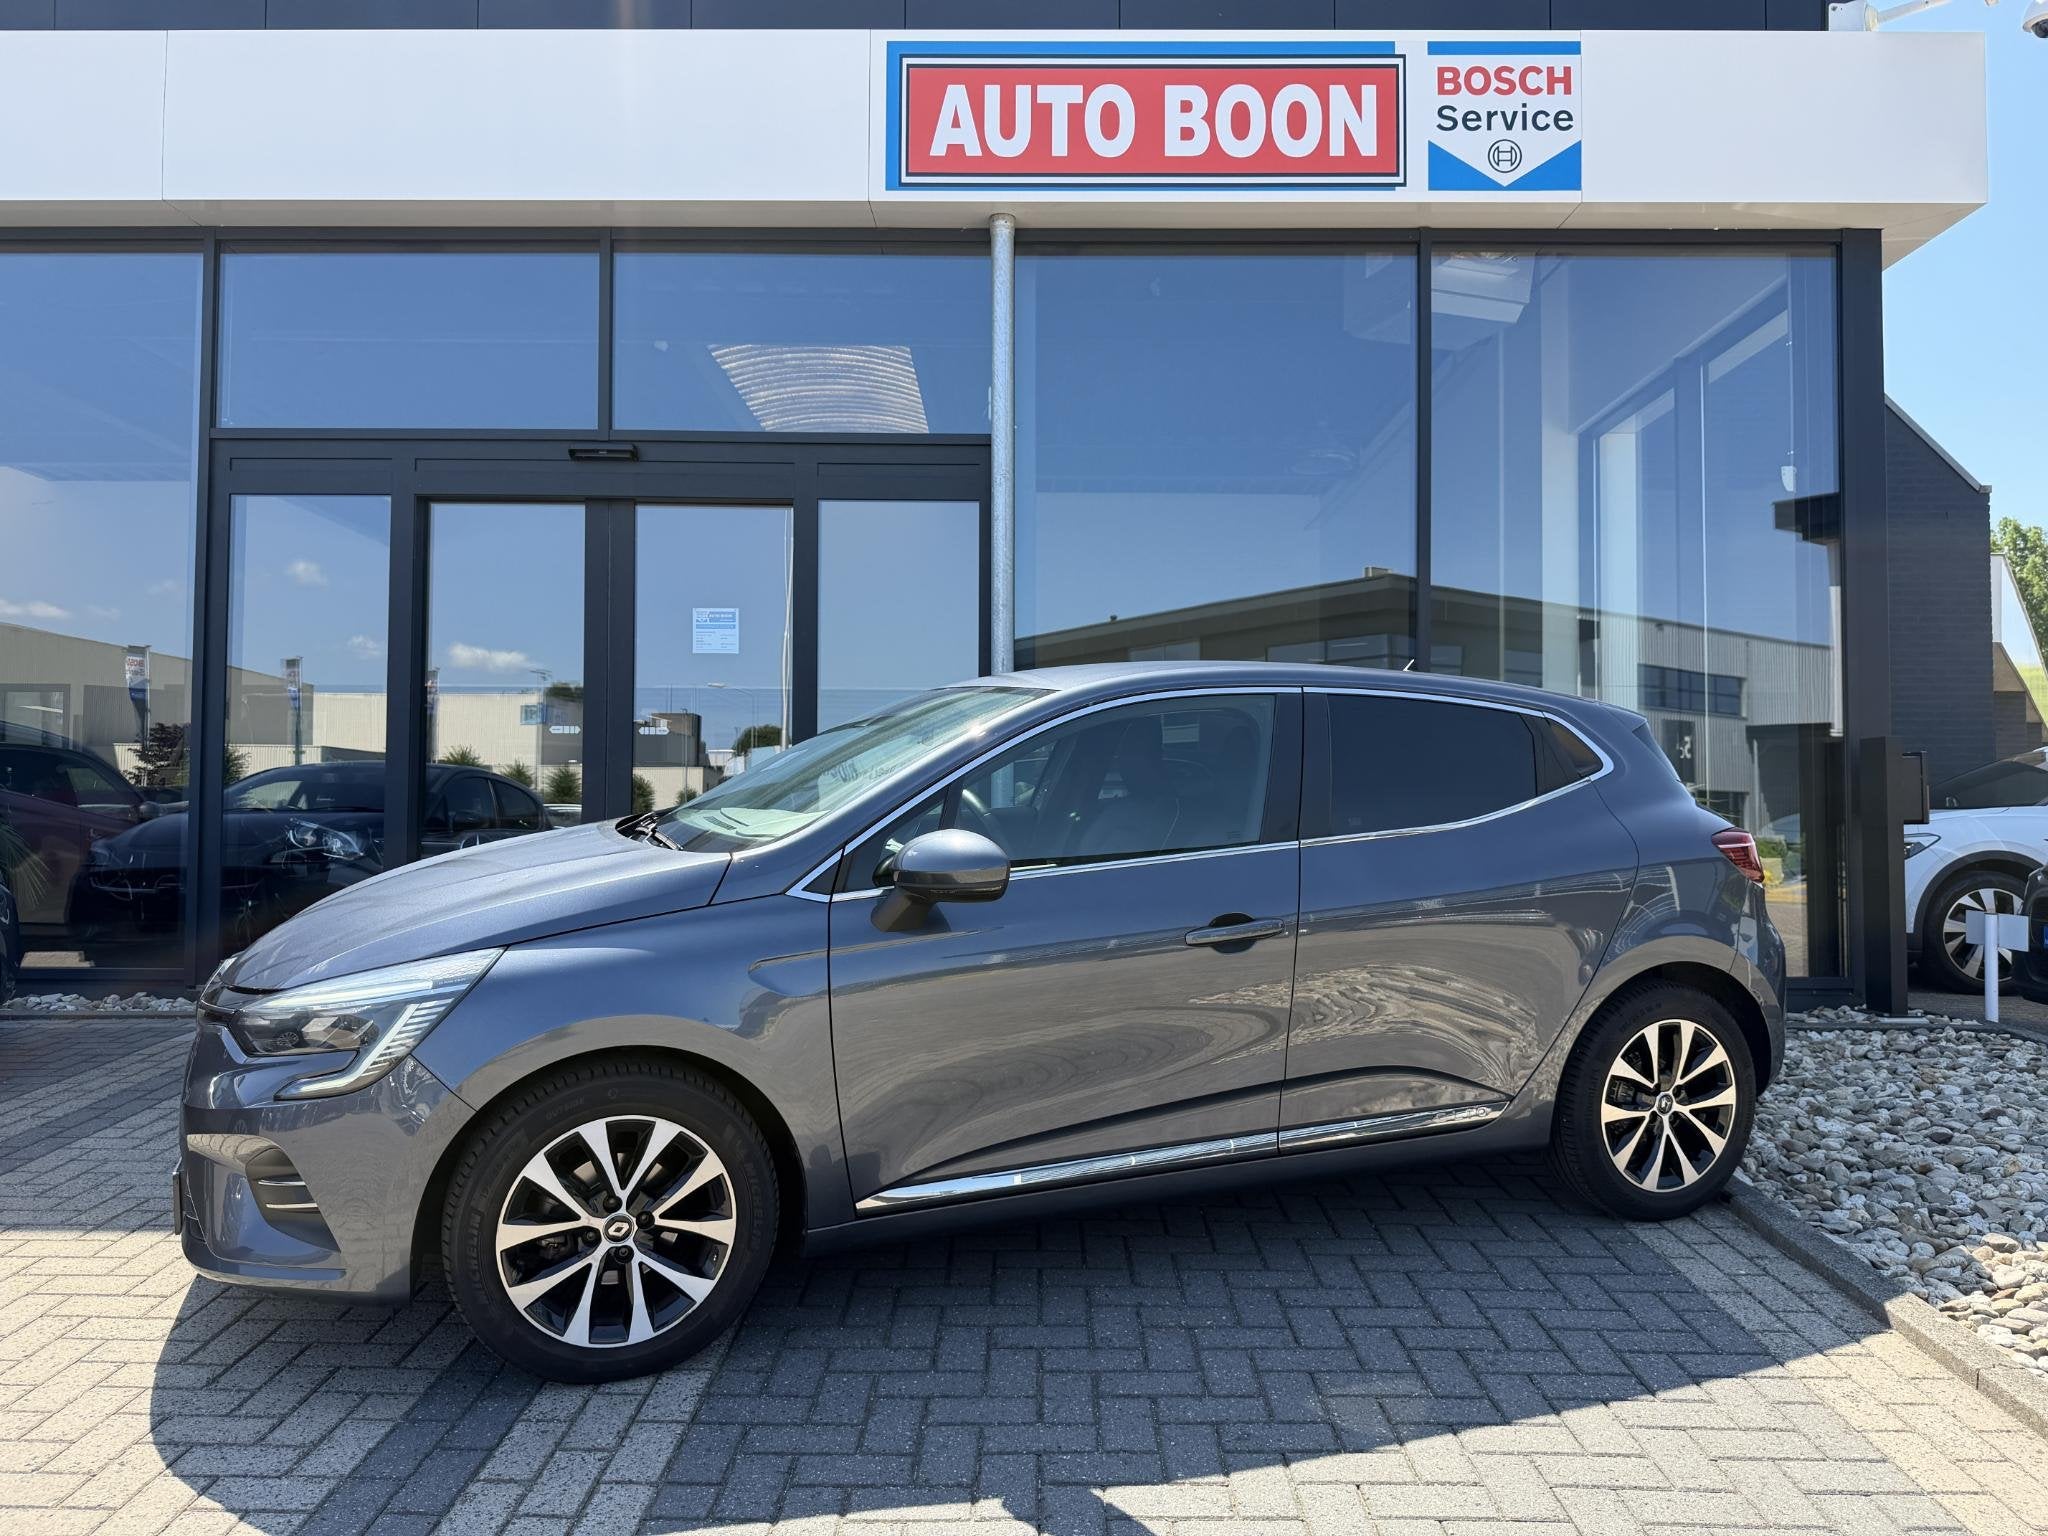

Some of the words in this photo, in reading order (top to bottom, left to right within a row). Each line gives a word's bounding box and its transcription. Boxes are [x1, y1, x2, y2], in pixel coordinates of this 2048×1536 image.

[1437, 66, 1572, 96] BOSCH
[930, 84, 1136, 158] AUTO
[1165, 84, 1378, 158] BOON
[1436, 103, 1574, 132] Service
[464, 1211, 491, 1304] MICHELIN
